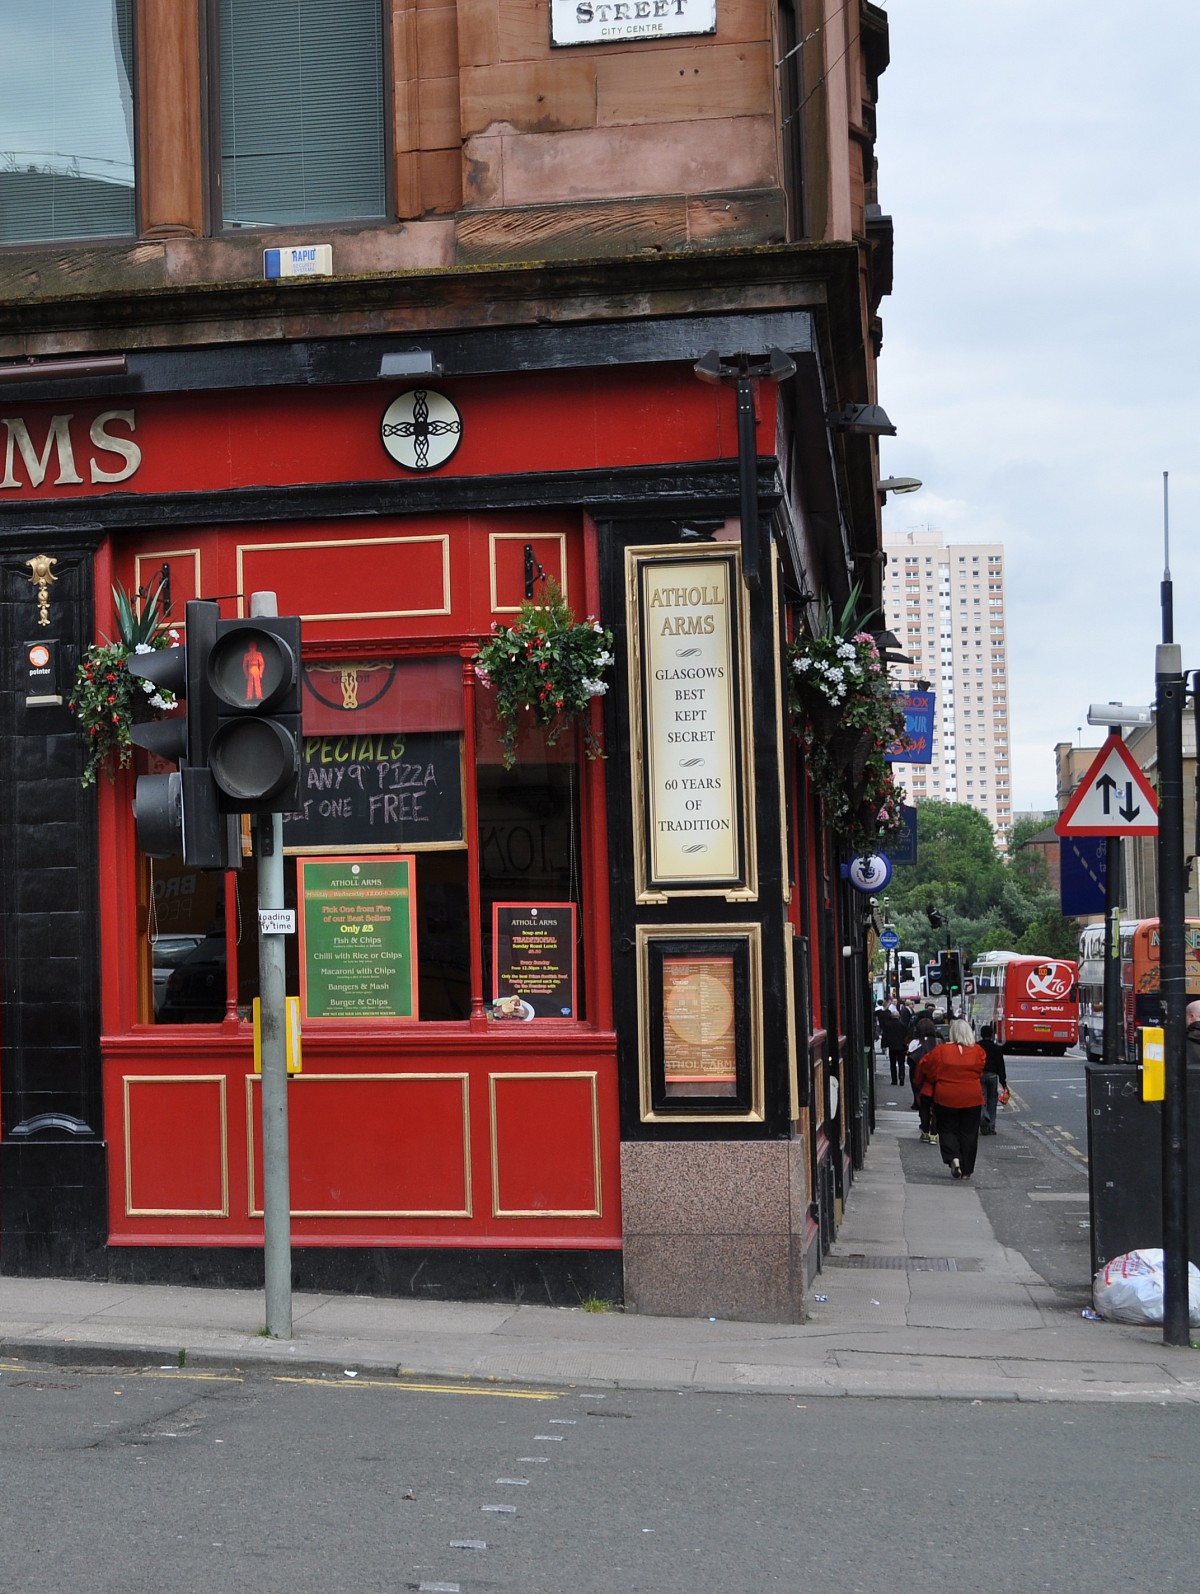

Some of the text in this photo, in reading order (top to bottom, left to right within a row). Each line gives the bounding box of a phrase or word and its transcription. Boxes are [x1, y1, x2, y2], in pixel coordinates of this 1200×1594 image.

[576, 0, 688, 24] STREET
[601, 23, 664, 36] CITY CENTRE
[292, 249, 316, 262] RAPID
[650, 585, 725, 608] ATHOLL
[660, 614, 715, 636] ARMS
[655, 667, 724, 680] GLASGOWS
[675, 689, 706, 701] BEST
[674, 709, 707, 722] KEPT
[667, 731, 716, 743] SECRET
[302, 734, 406, 764] PECIALS
[307, 766, 345, 790] ANY
[377, 762, 438, 790] PIZZA
[664, 778, 721, 790] 60 YEARS
[318, 797, 353, 819] ONE
[369, 790, 430, 825] FREE
[685, 799, 702, 811] OF
[658, 819, 730, 832] TRADITION
[330, 879, 359, 887] ATHOLL
[272, 922, 292, 930] time
[340, 924, 374, 934] Only £5
[359, 936, 382, 945] Chips
[380, 951, 402, 960] Chips
[356, 967, 373, 975] with
[374, 967, 396, 975] Chips
[328, 983, 359, 992] Bangers
[369, 982, 389, 990] Mash
[330, 999, 355, 1007] Burger
[366, 998, 388, 1006] Chips
